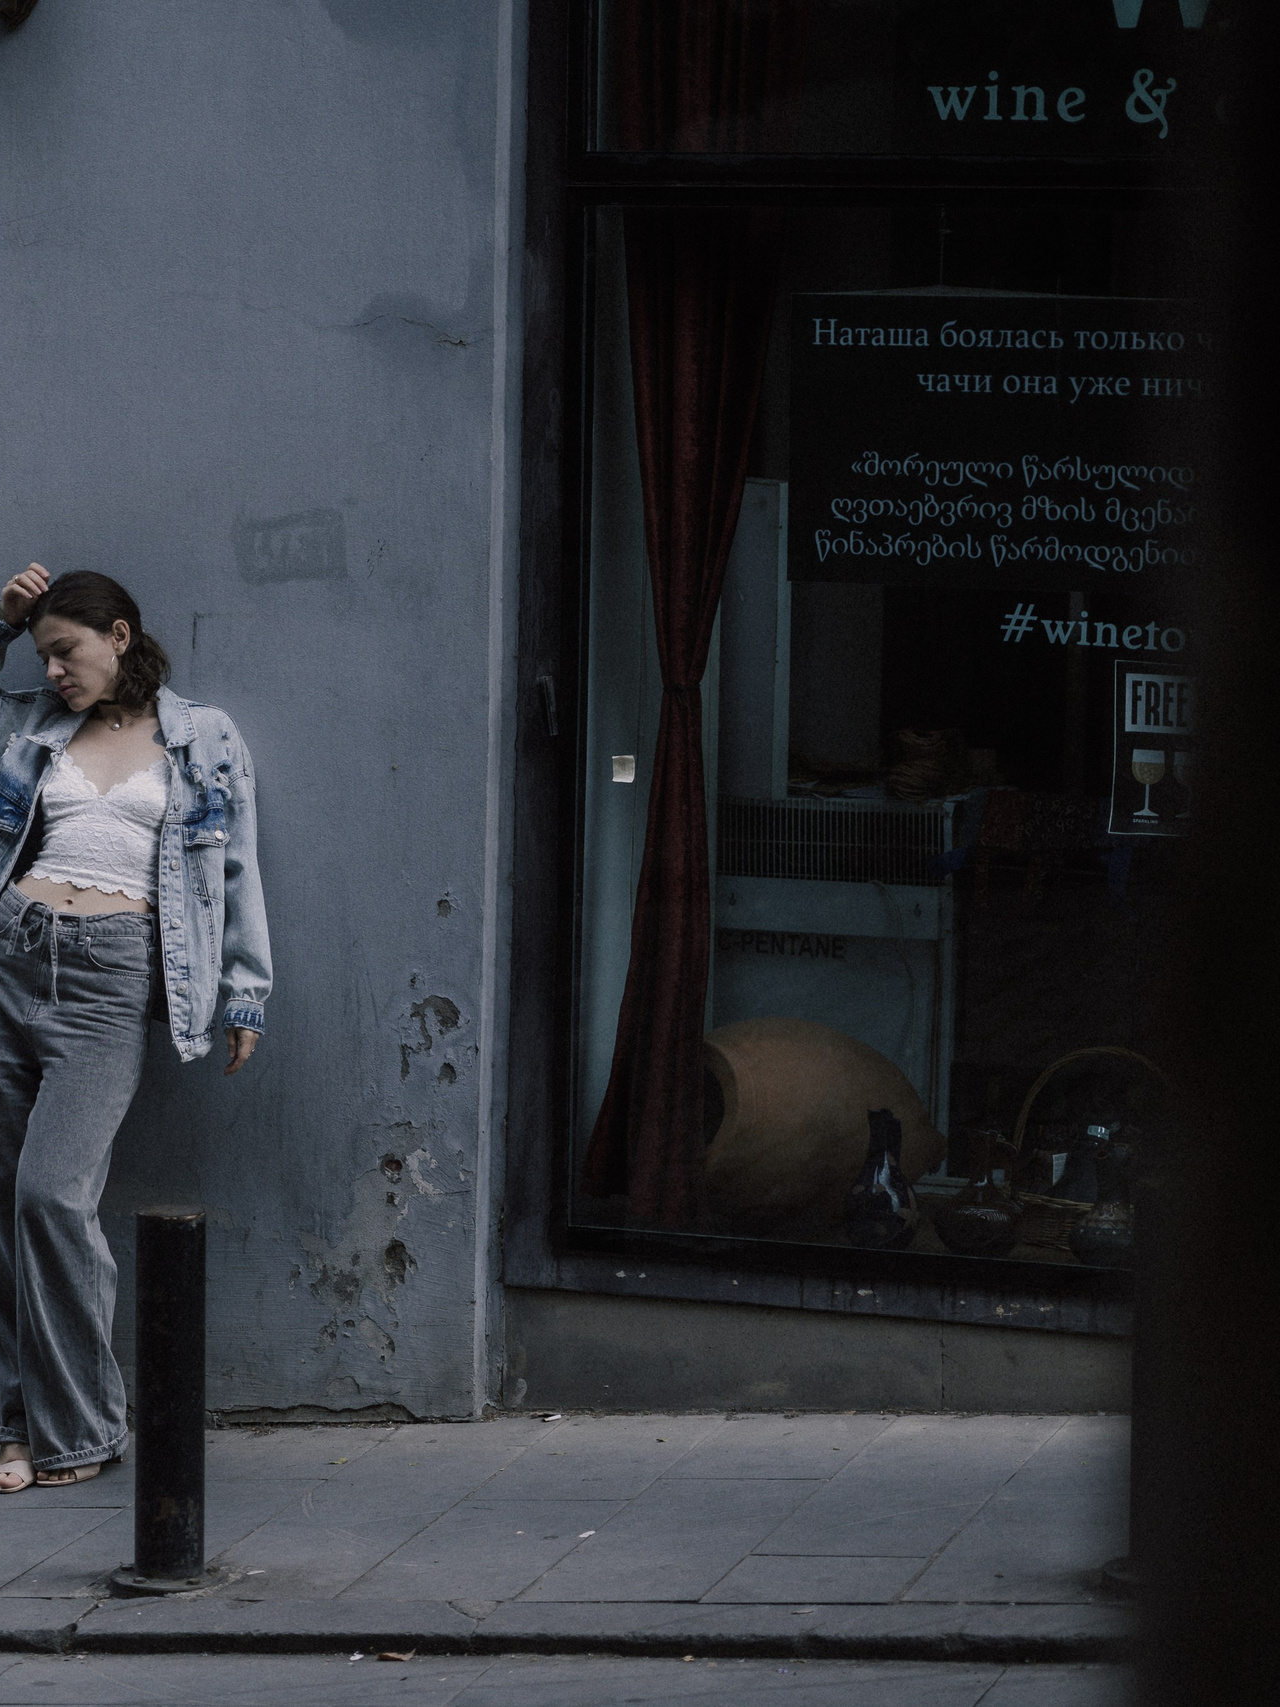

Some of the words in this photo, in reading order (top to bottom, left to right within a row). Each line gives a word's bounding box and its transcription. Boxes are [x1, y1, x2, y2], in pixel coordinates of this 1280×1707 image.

[926, 70, 1087, 124] wine
[1124, 68, 1178, 140] &
[810, 316, 930, 348] Наташа
[939, 318, 1065, 350] боялась
[1073, 329, 1186, 352] только
[915, 373, 993, 394] чачи
[1002, 374, 1059, 395] она
[1068, 376, 1131, 405] уже
[1142, 377, 1208, 399] нич
[851, 450, 1014, 488] «შორეული
[1021, 454, 1198, 492] წარსულიდ
[830, 493, 1014, 529] ღვთაებვრივ
[1021, 494, 1097, 523] მზის
[814, 528, 983, 566] წინაპრების
[1000, 602, 1190, 653] #wineto
[1130, 679, 1190, 729] FREE
